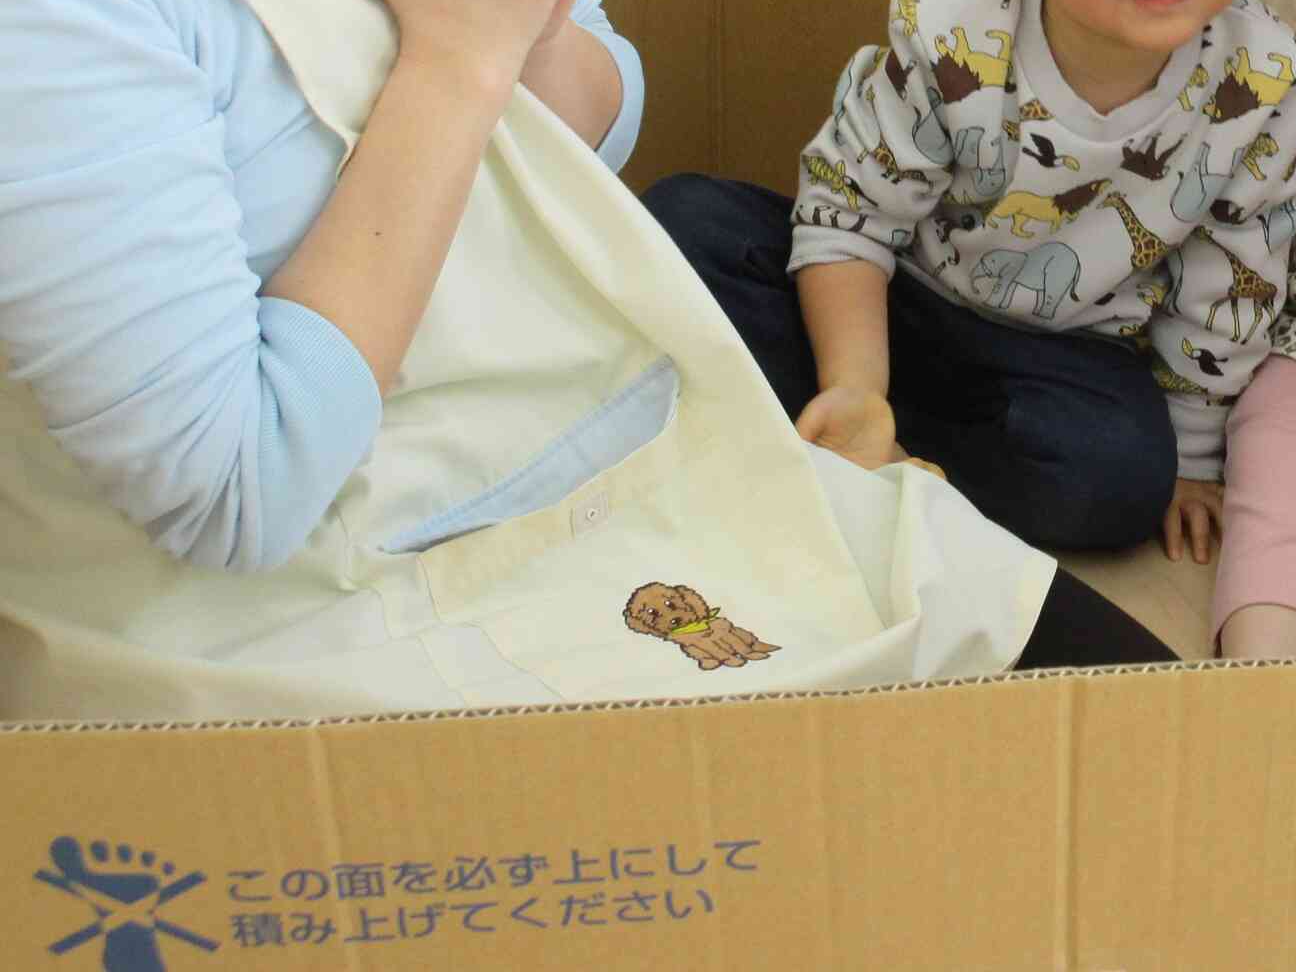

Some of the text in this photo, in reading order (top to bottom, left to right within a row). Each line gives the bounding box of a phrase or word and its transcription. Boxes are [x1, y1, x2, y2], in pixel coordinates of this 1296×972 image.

[227, 839, 761, 902] この面を必ず上にして
[231, 889, 715, 947] 積み上げてください
